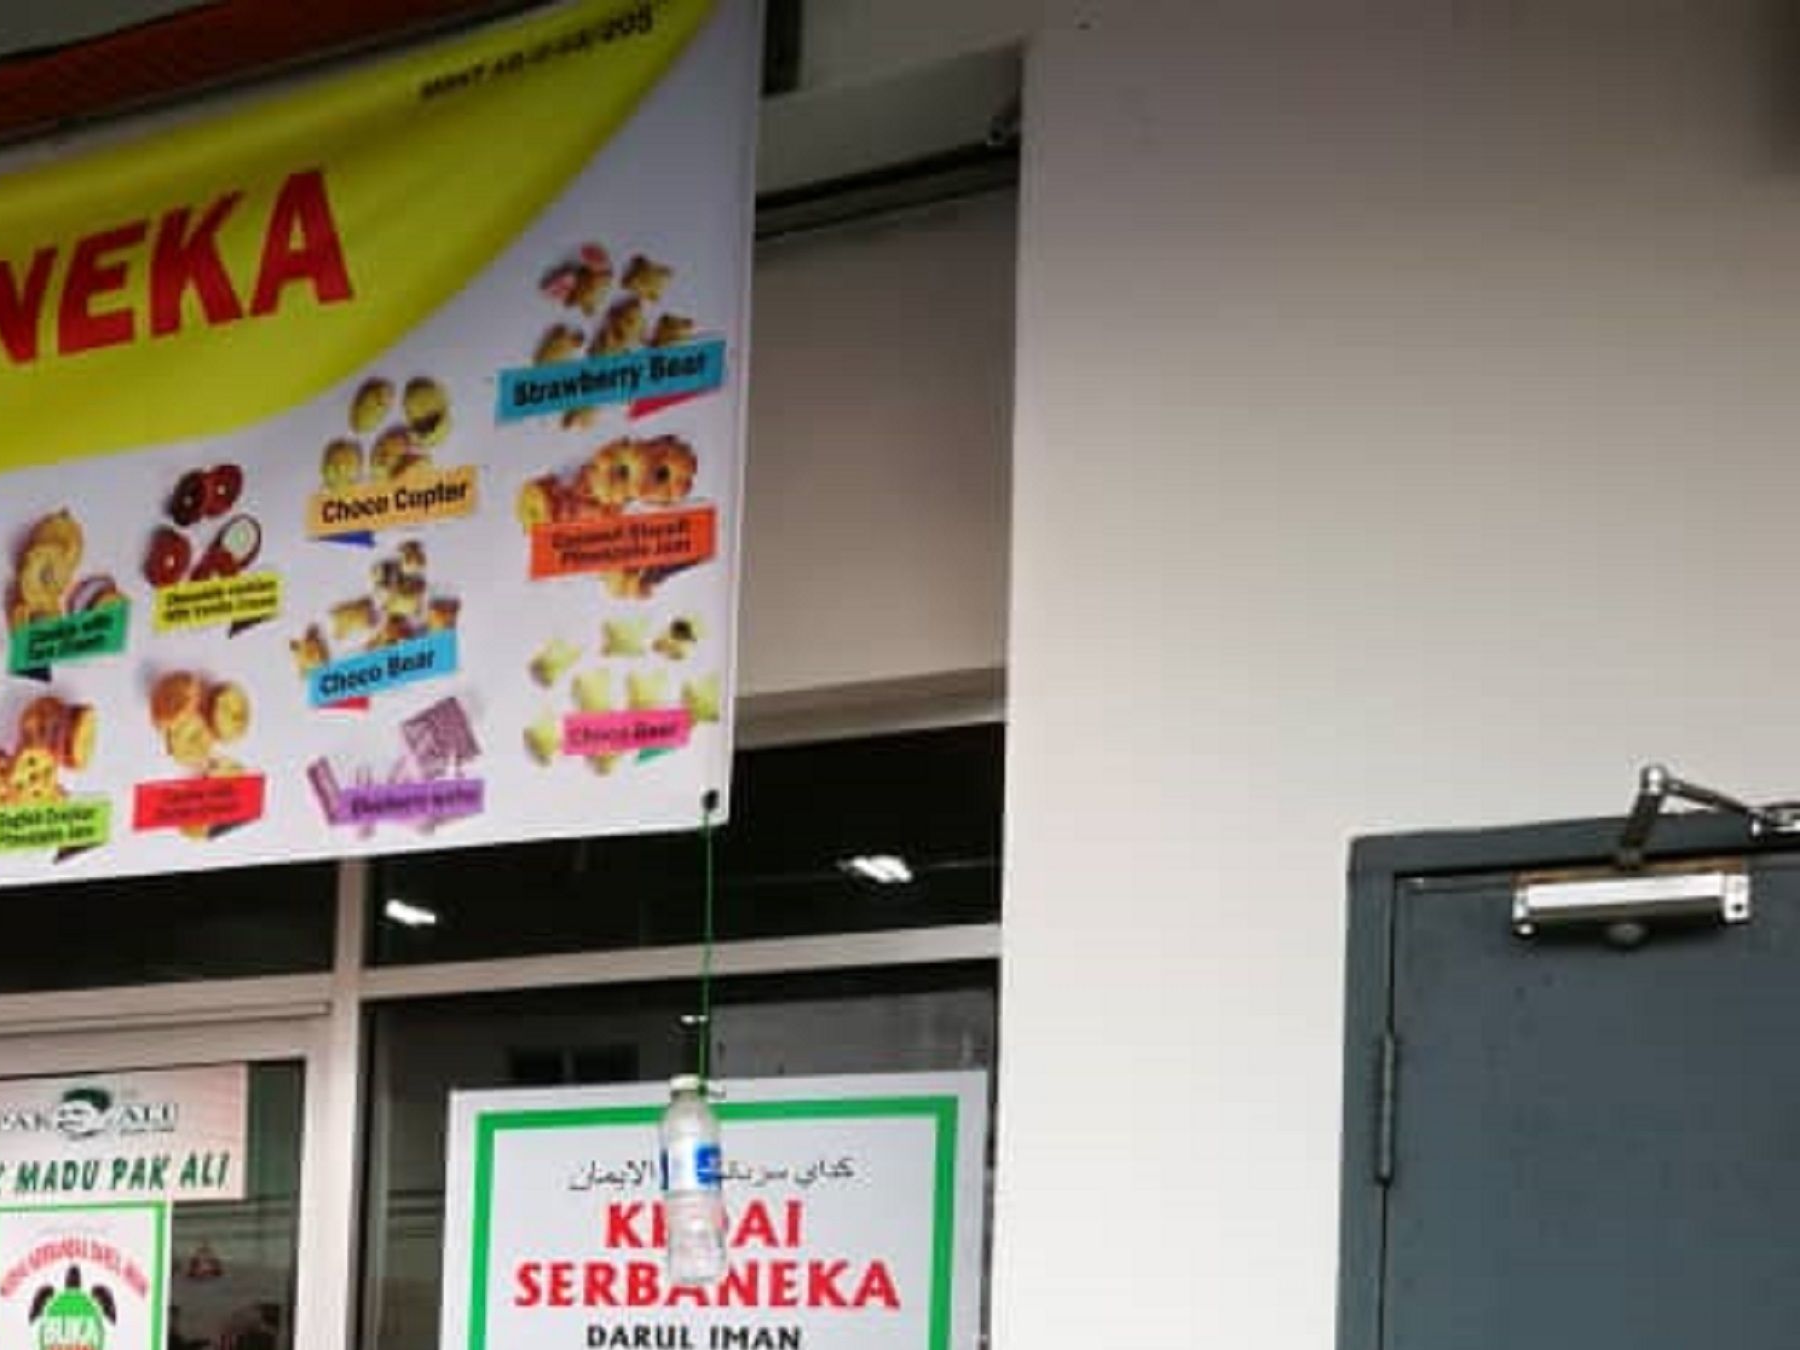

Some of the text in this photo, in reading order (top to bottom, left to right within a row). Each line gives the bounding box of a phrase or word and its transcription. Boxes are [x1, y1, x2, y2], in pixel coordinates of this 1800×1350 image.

[513, 353, 707, 407] Strawberry Bear
[322, 492, 389, 524] Choco
[320, 650, 435, 696] Choco Bear
[16, 1159, 100, 1191] MADU
[112, 1156, 170, 1189] PAK
[181, 1152, 229, 1186] ALI
[605, 1199, 803, 1249] KAI
